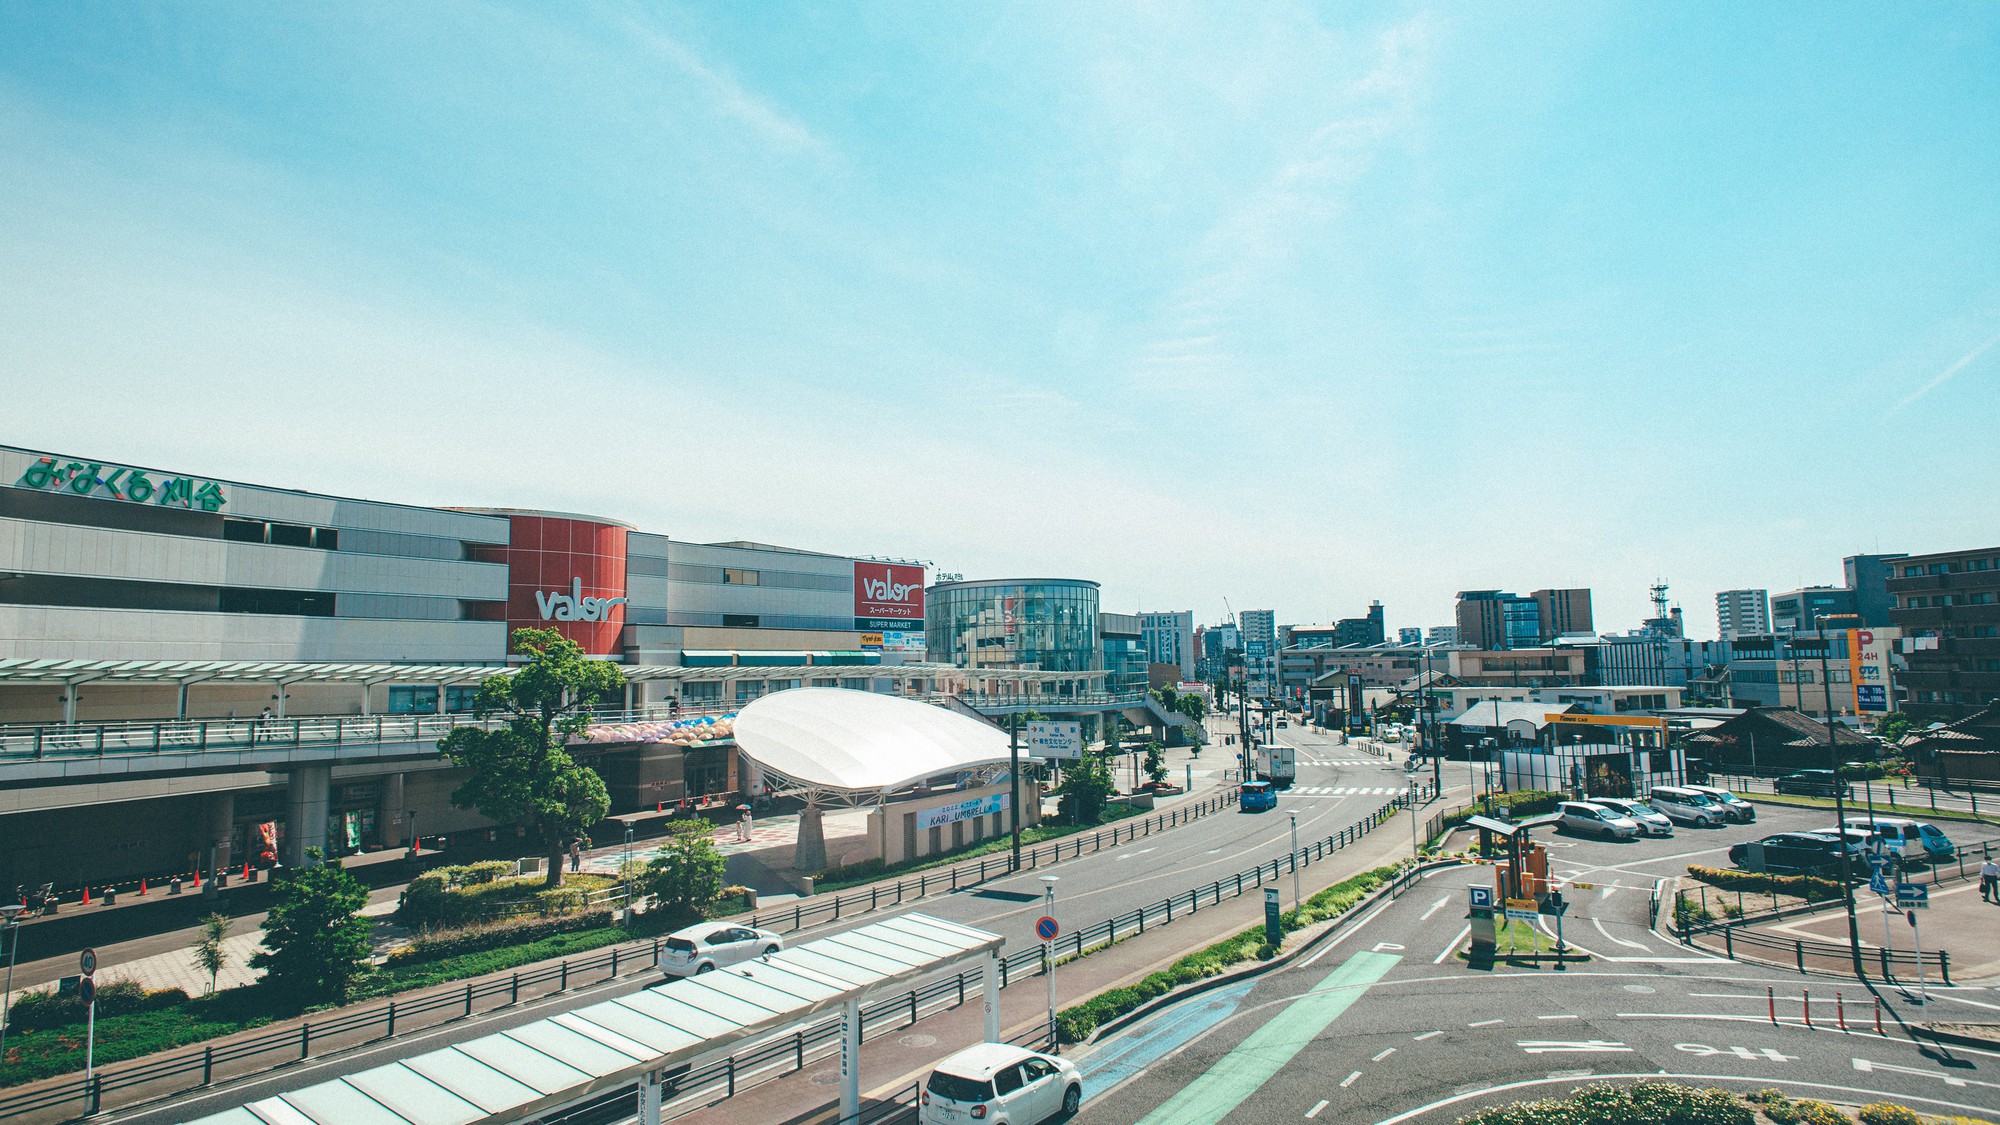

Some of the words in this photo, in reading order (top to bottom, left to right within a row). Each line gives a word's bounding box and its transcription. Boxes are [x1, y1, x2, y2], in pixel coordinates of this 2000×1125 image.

[863, 568, 920, 602] valor
[869, 607, 912, 615] スーパーマーケット
[869, 621, 889, 629] SUPER
[889, 621, 912, 629] MARKET
[1857, 631, 1874, 651] P
[1857, 652, 1878, 661] 24H
[1267, 893, 1272, 901] P
[1473, 890, 1487, 904] P
[83, 955, 93, 969] 40
